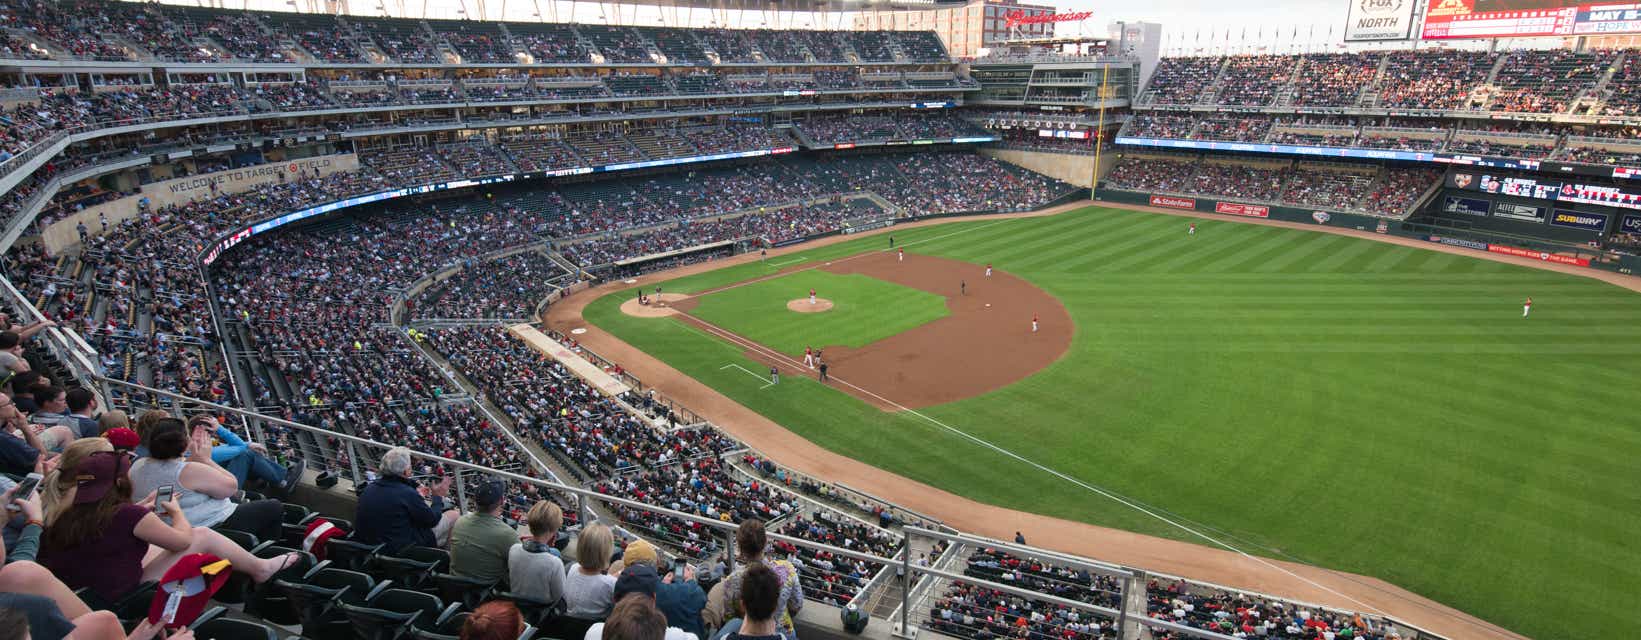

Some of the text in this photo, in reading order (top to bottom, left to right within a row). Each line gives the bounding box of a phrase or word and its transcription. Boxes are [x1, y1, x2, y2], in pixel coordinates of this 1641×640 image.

[1003, 8, 1093, 28] Budweiser
[1589, 10, 1621, 20] MAY
[1357, 17, 1399, 28] NORTH
[1596, 22, 1629, 31] HOPE
[169, 159, 331, 193] WELCOME TO TARGET FIELD
[1556, 214, 1601, 225] SUBWAY
